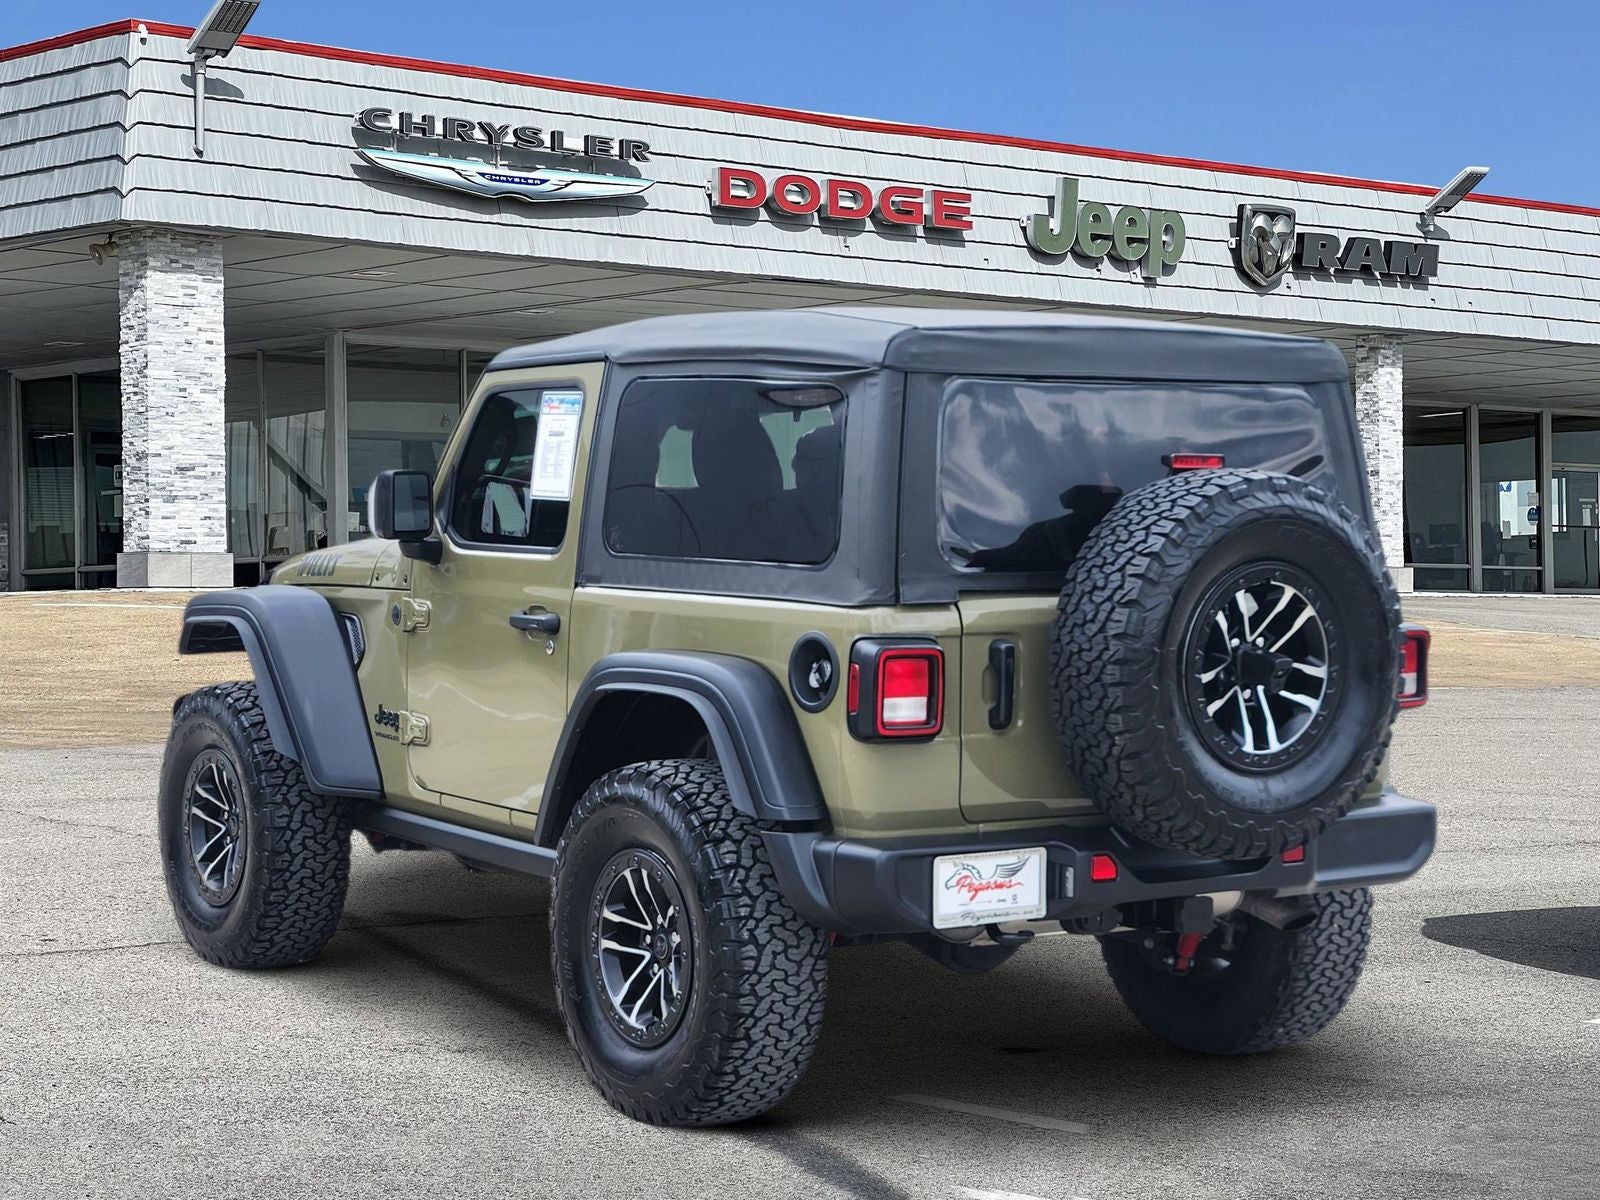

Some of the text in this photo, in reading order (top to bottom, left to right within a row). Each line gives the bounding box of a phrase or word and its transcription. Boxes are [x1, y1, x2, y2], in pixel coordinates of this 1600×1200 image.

[357, 106, 652, 163] CHRYSLER
[483, 172, 542, 186] CHRYSLER
[711, 166, 974, 231] DODGE
[1026, 176, 1186, 278] Jeep
[1298, 231, 1440, 278] RAM
[374, 703, 400, 732] Jeep
